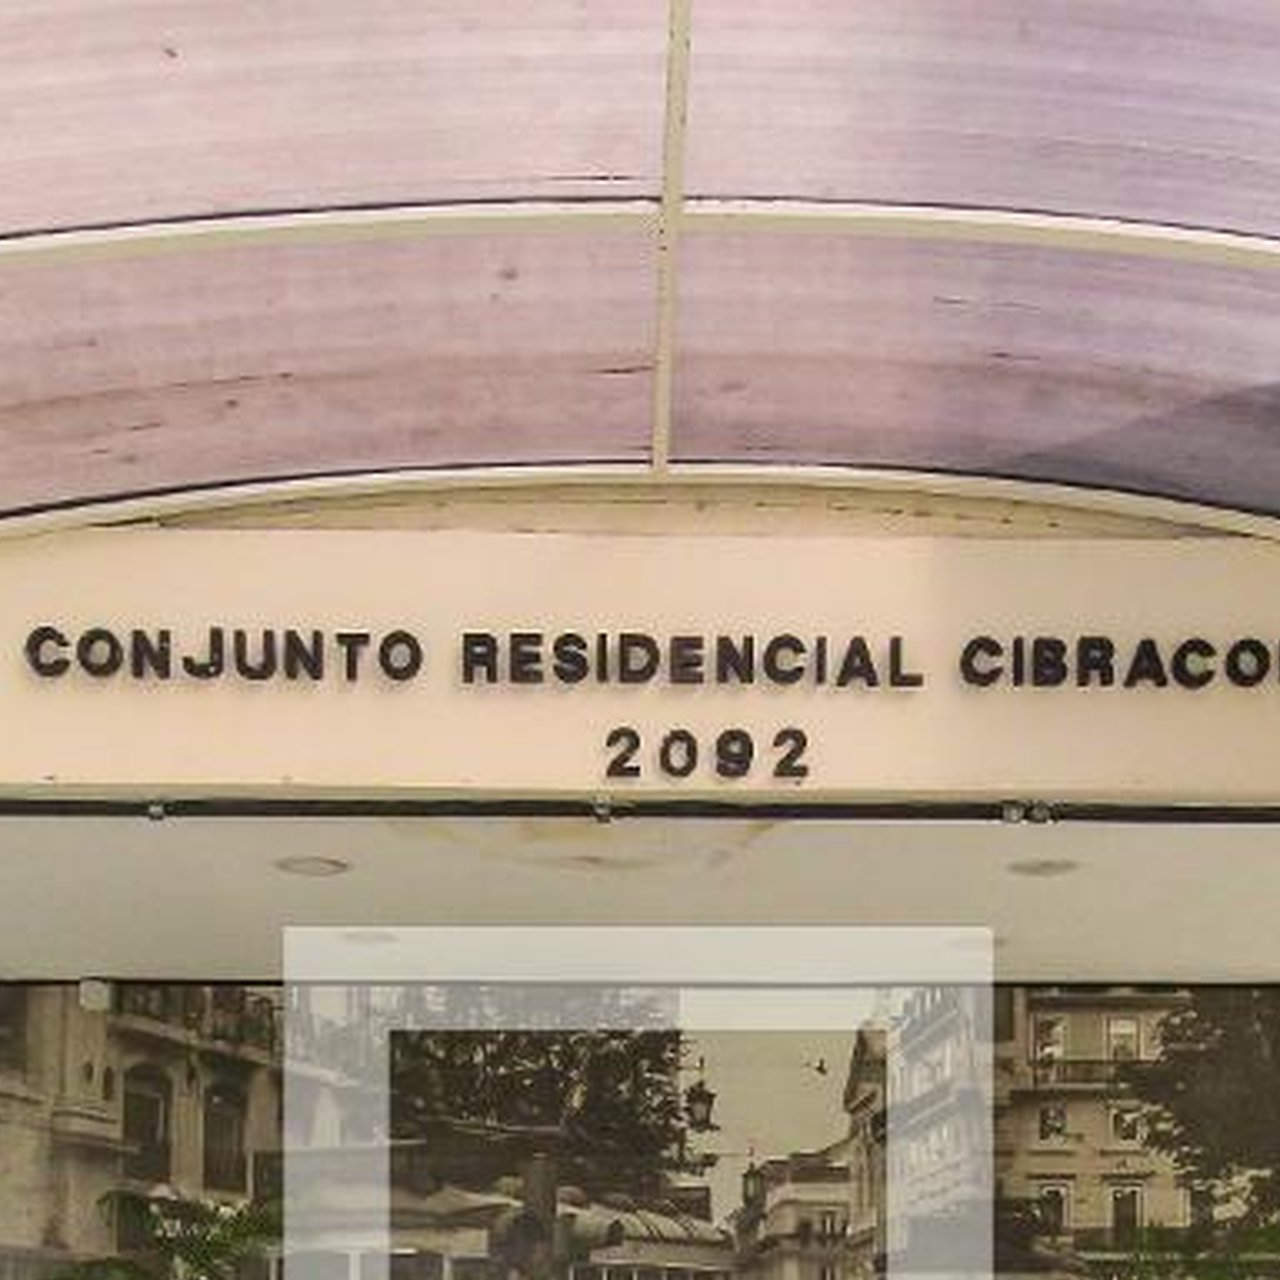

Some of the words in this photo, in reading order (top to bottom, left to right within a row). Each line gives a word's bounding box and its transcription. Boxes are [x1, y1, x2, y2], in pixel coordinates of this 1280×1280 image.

[24, 625, 424, 683] CONJUNTO
[461, 632, 924, 689] RESIDENCIAL
[605, 726, 811, 779] 2092
